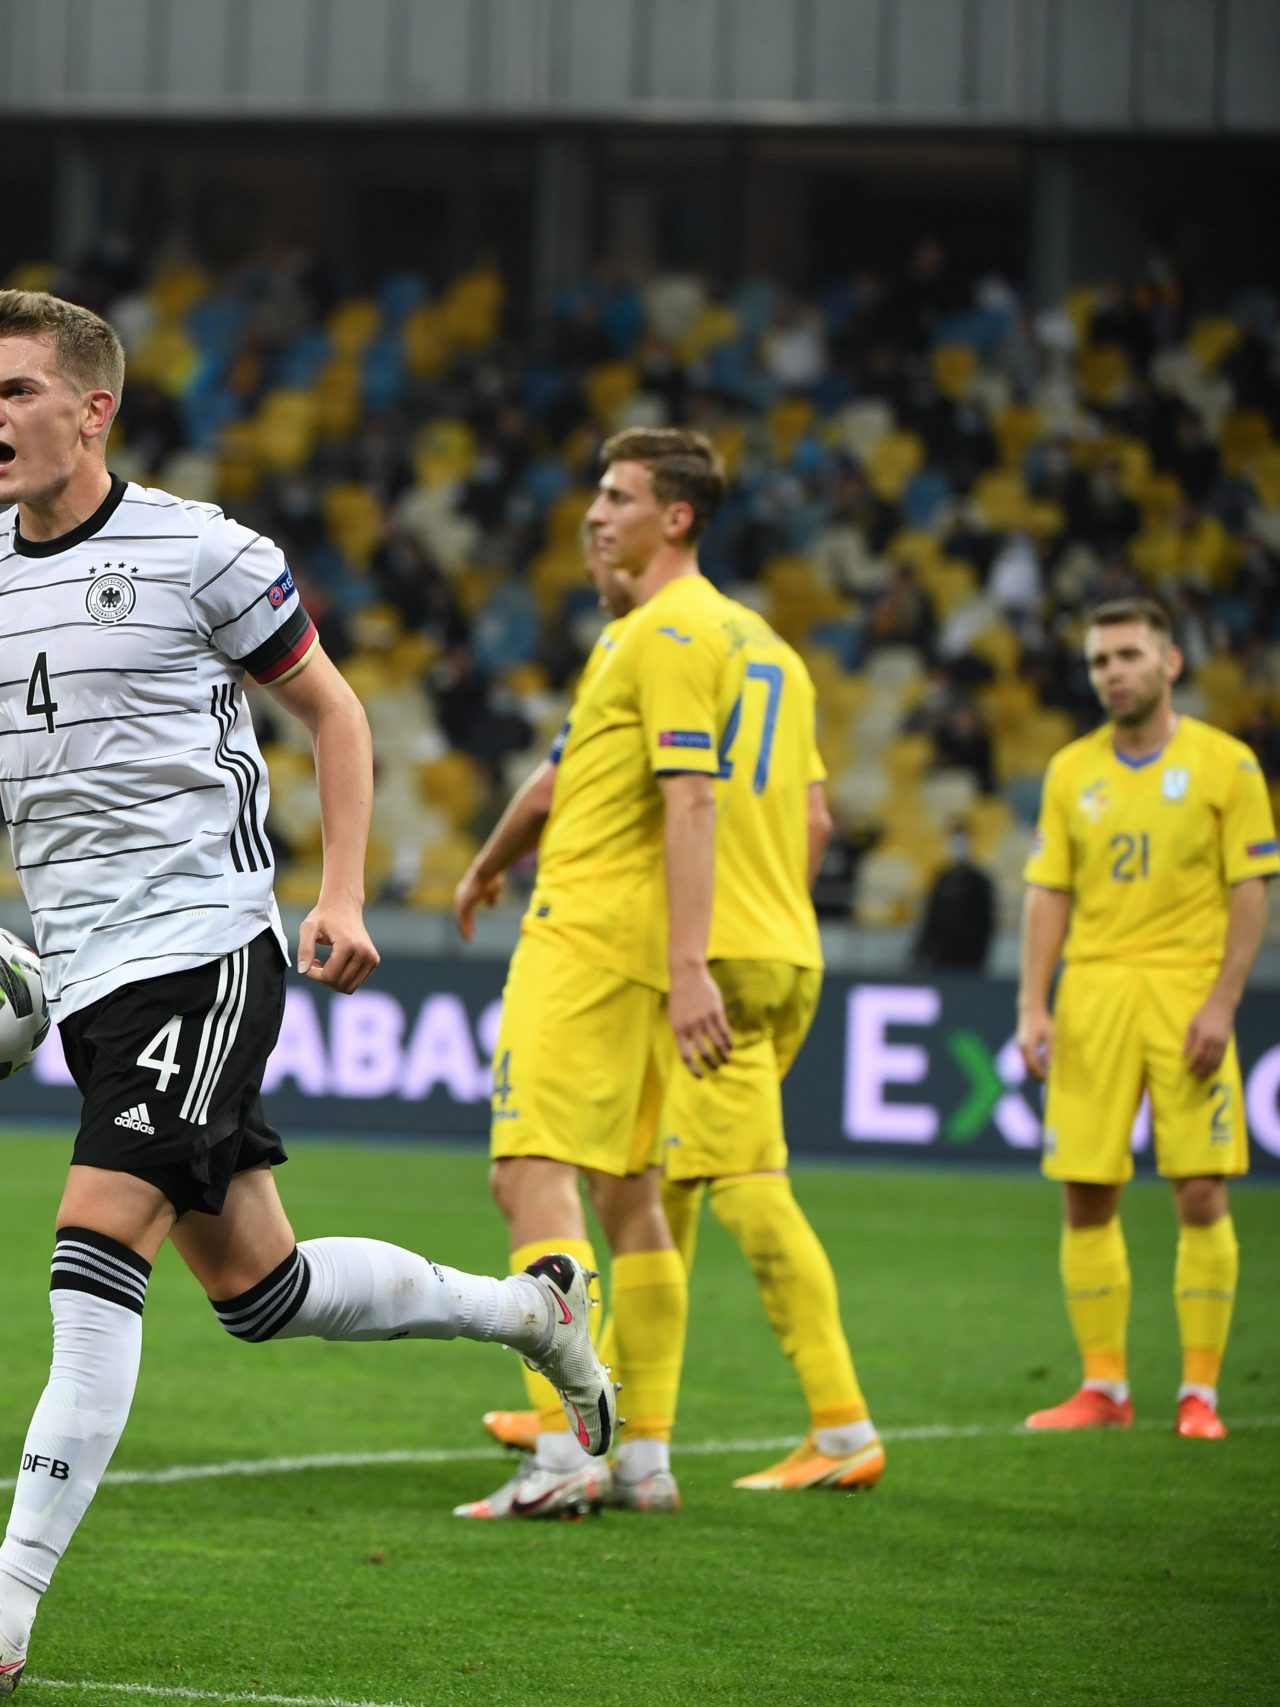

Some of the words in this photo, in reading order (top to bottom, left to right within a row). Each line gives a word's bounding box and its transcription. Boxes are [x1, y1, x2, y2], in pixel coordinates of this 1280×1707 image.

[26, 652, 58, 734] 4
[1110, 832, 1149, 882] 21
[136, 1014, 183, 1092] 4
[114, 1116, 155, 1135] adidas
[23, 1453, 70, 1480] DFB
